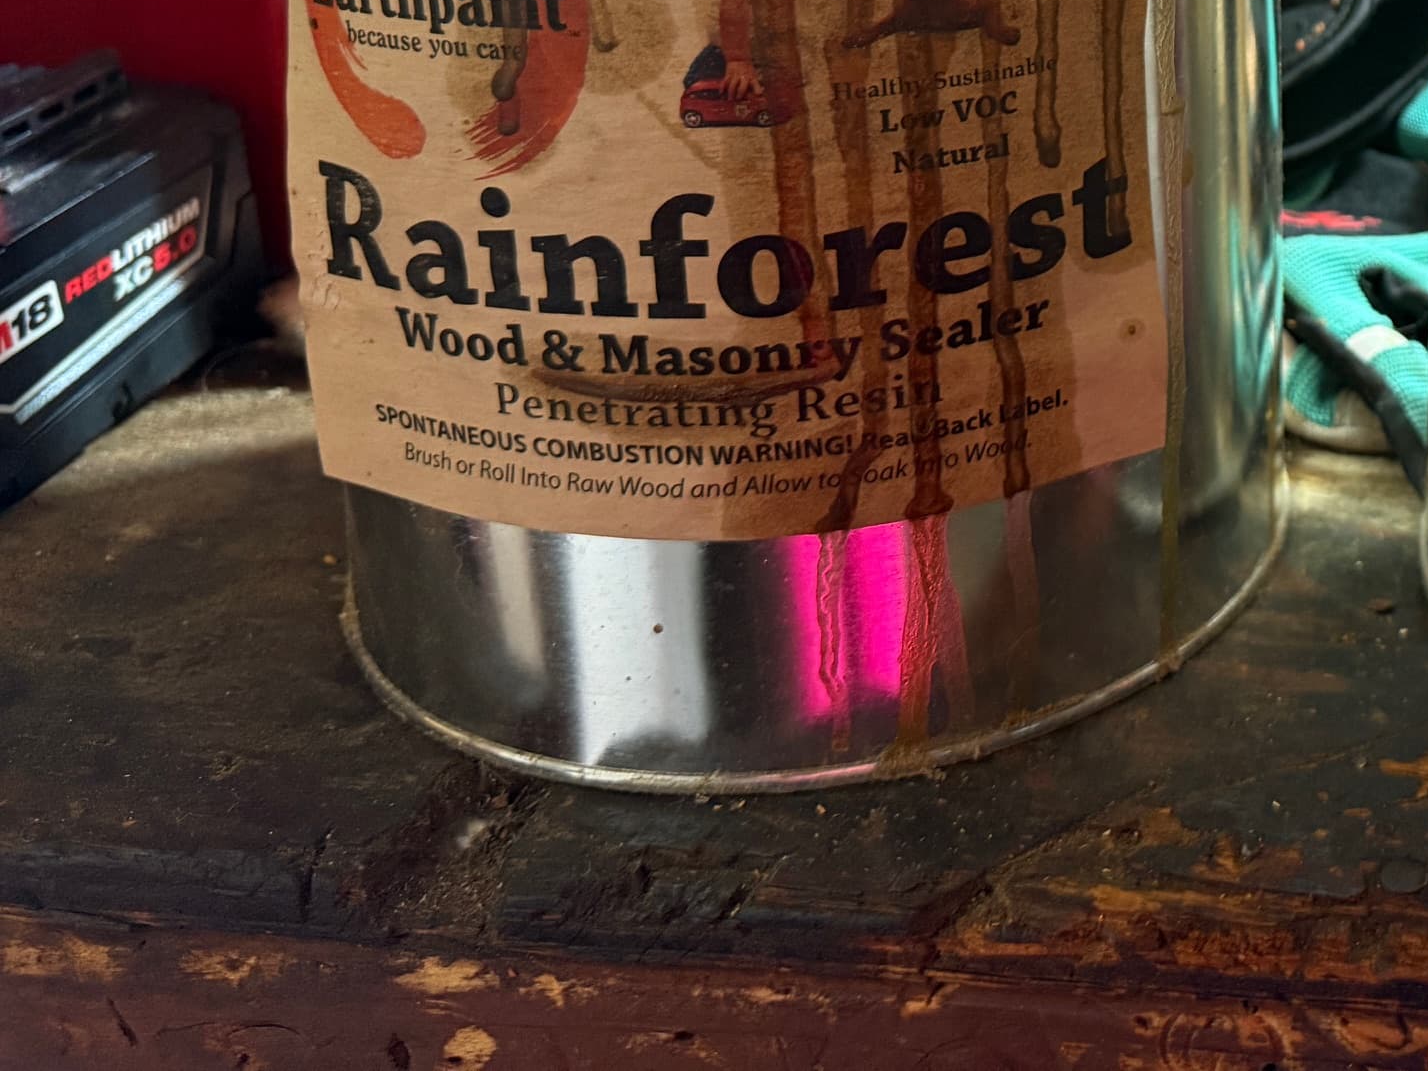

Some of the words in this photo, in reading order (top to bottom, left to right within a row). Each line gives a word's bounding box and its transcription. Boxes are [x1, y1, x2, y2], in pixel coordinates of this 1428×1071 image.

[345, 20, 423, 53] because
[429, 37, 468, 59] you
[476, 40, 523, 61] care
[832, 75, 927, 102] Healthy
[933, 56, 1058, 90] Sustainable
[879, 109, 945, 133] Low
[952, 90, 1019, 123] VOC
[892, 133, 1011, 174] Natural
[318, 158, 1133, 320] Rainforest
[395, 306, 529, 367] Wood
[541, 330, 586, 375] &
[598, 333, 862, 381] Masonry
[880, 298, 1050, 362] Sealer
[375, 403, 527, 454] SPONTANEOUS
[532, 436, 702, 467] COMBUSTION
[709, 434, 854, 467] WARNING!
[934, 409, 992, 440] Back
[999, 389, 1069, 425] Label.
[495, 382, 778, 439] Penetrating
[796, 374, 944, 424] Resin
[404, 442, 452, 472] Brush
[456, 460, 476, 477] or
[480, 463, 515, 485] Roll
[521, 466, 562, 491] Into
[567, 472, 613, 495] Raw
[619, 475, 684, 499] Wood
[690, 471, 738, 498] and
[742, 467, 811, 497] Allow
[818, 469, 841, 490] to
[851, 459, 908, 486] Soak
[965, 435, 1032, 465] Wood.
